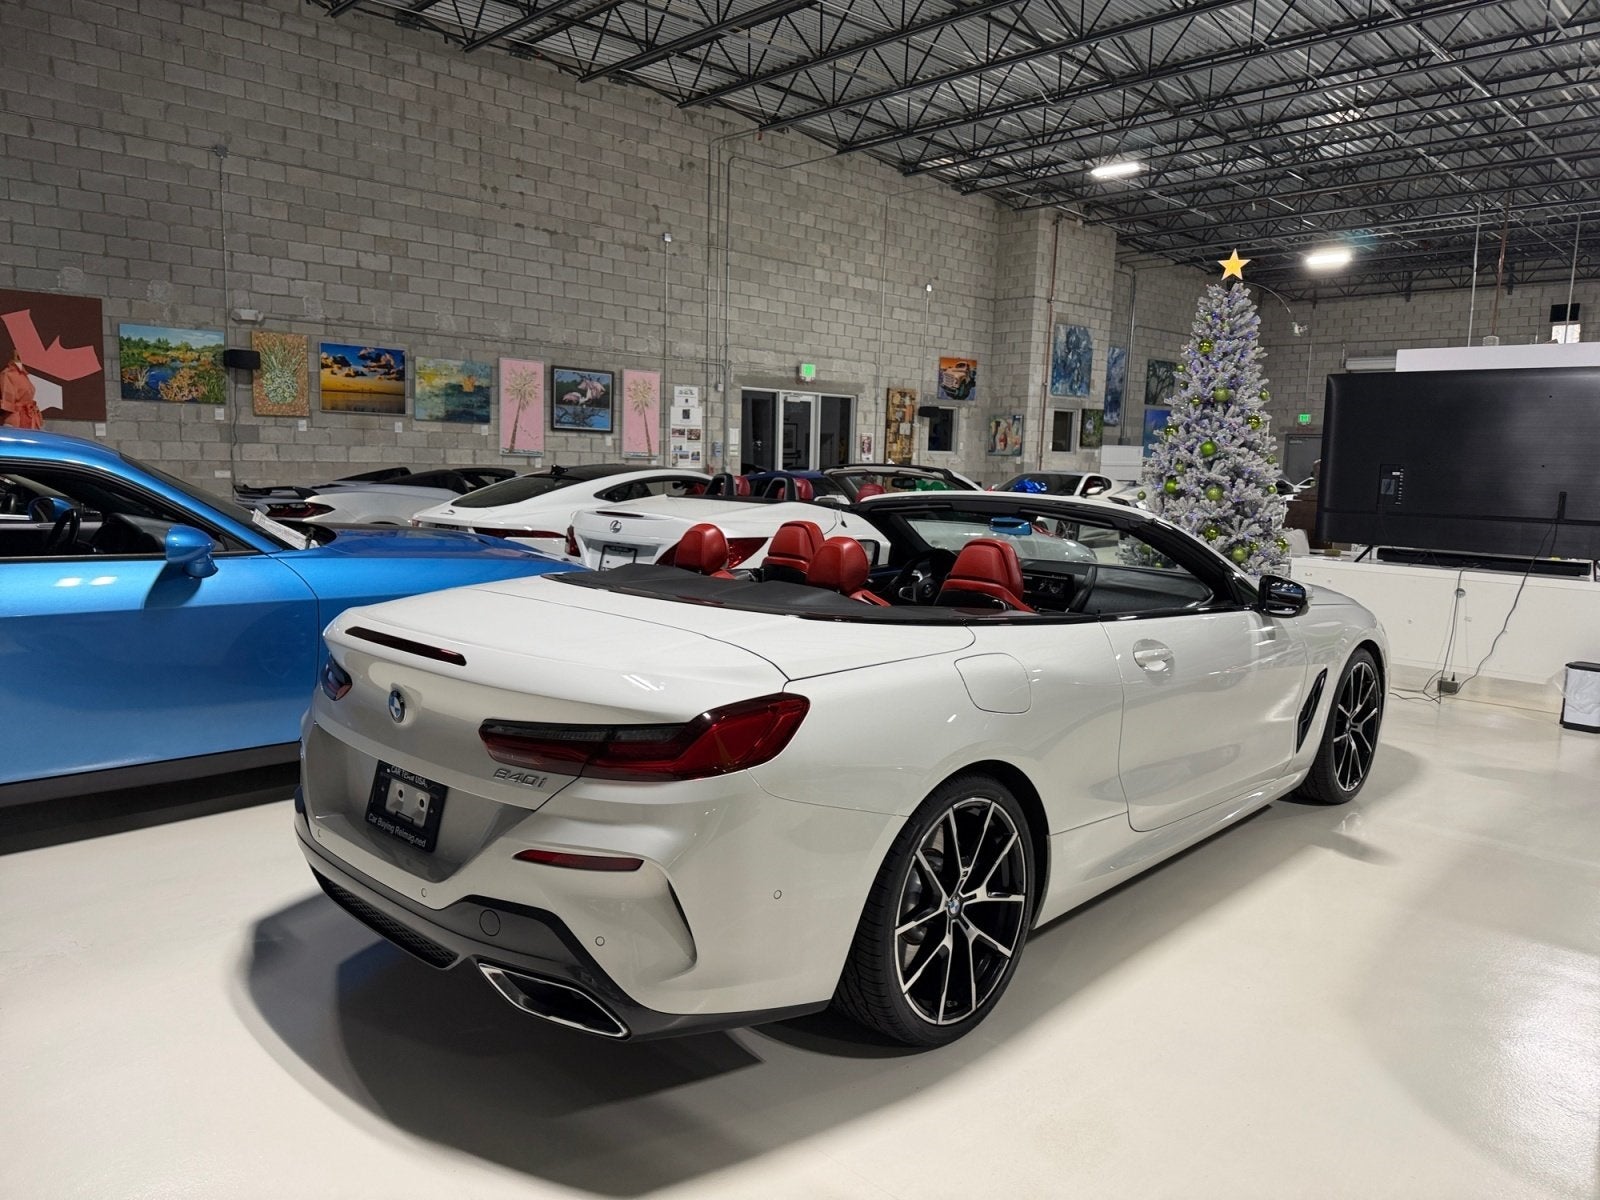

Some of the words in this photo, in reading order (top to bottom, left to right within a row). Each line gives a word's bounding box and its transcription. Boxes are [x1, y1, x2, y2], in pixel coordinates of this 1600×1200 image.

[493, 768, 547, 788] 840i
[368, 812, 378, 824] Car
[377, 817, 395, 835] Buying
[395, 826, 427, 848] Reimagined
